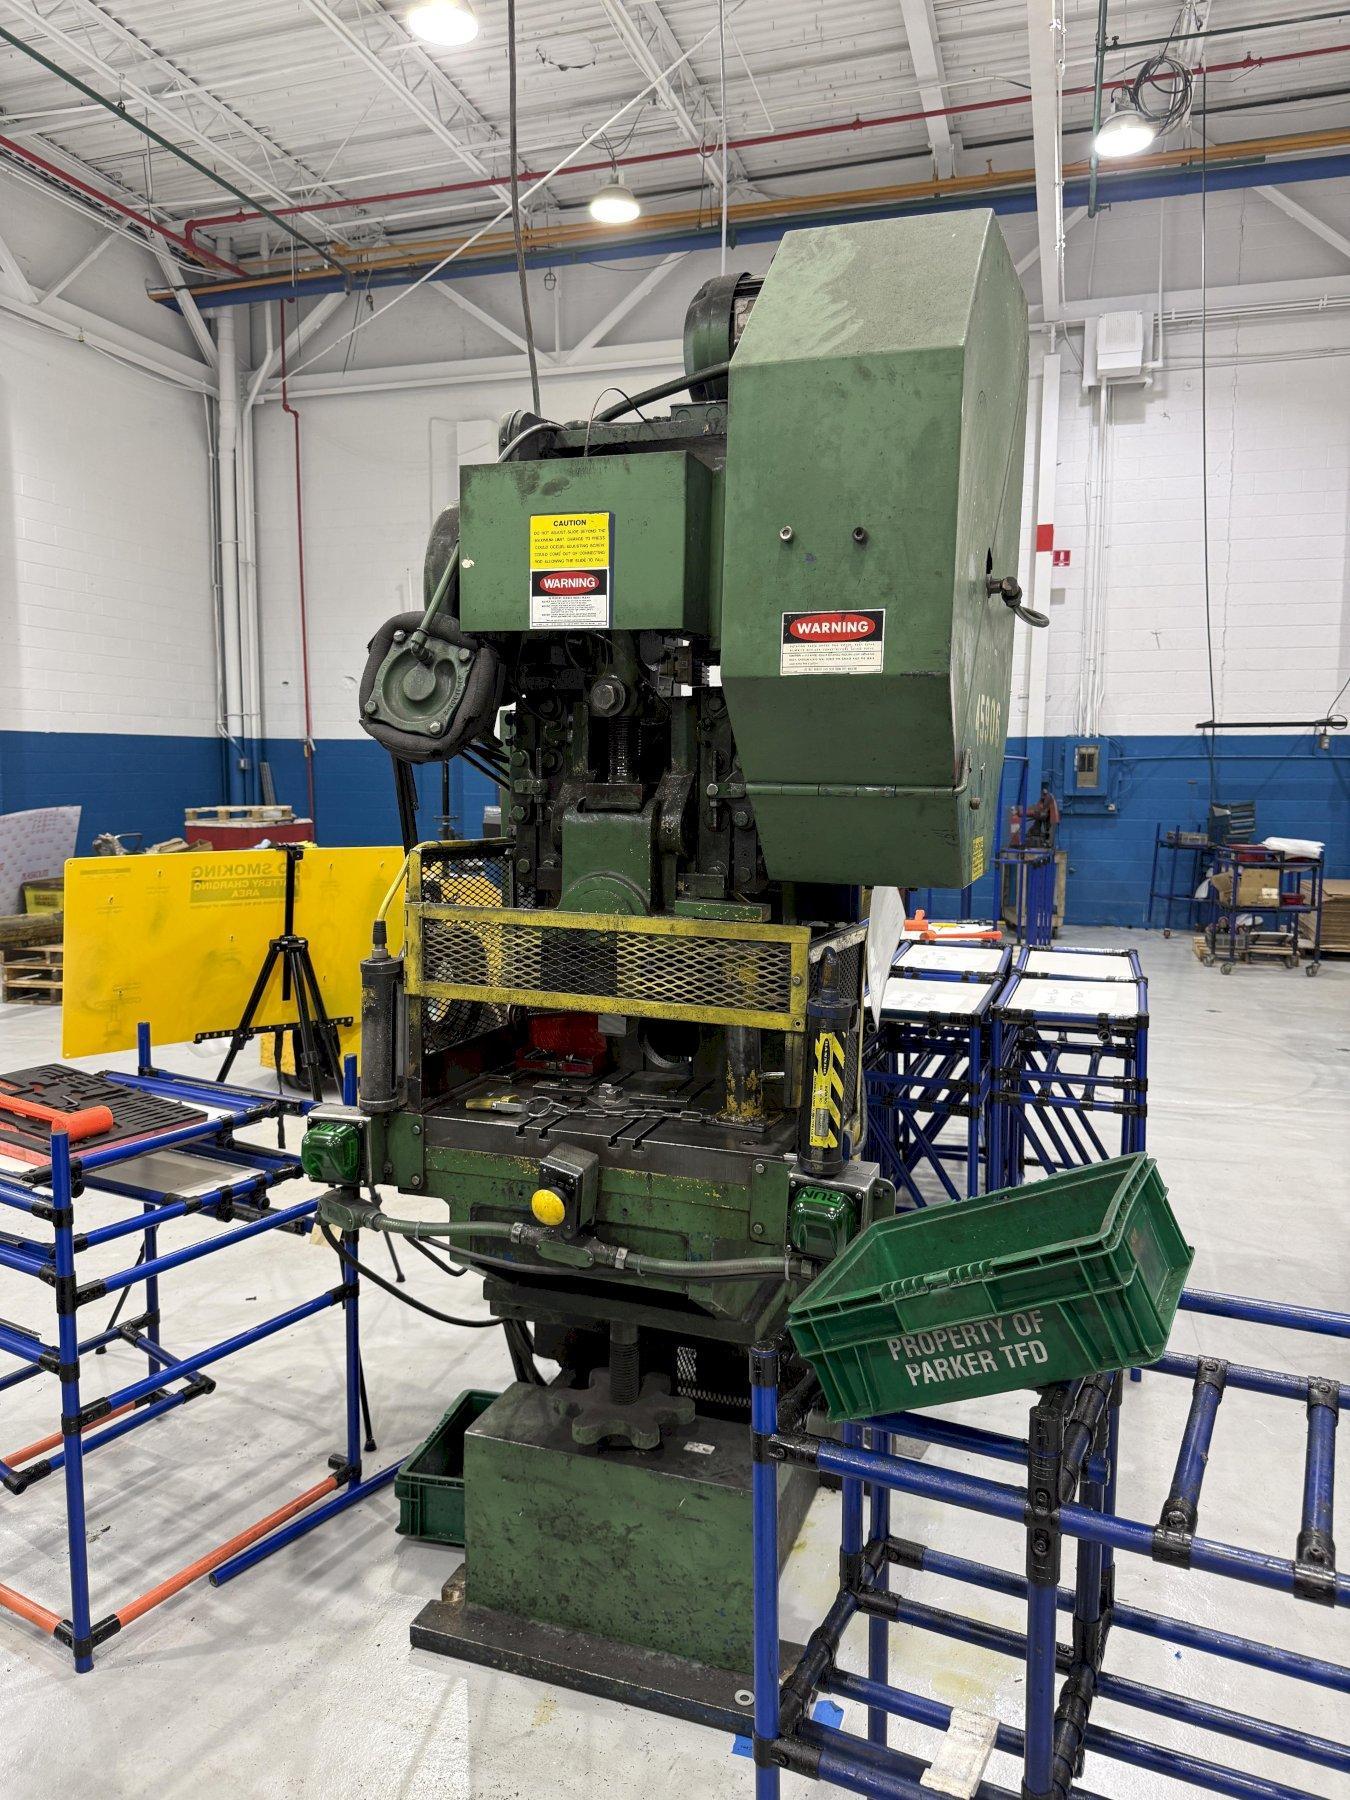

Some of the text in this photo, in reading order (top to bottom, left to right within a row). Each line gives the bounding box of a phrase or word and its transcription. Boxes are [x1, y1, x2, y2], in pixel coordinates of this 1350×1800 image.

[553, 519, 587, 527] CAUTION
[544, 577, 595, 588] WARNING
[797, 621, 869, 634] WARNING
[799, 1190, 840, 1205] RUN
[887, 1310, 1044, 1361] PROPERTY OF
[905, 1340, 1049, 1386] PARKER TFD
